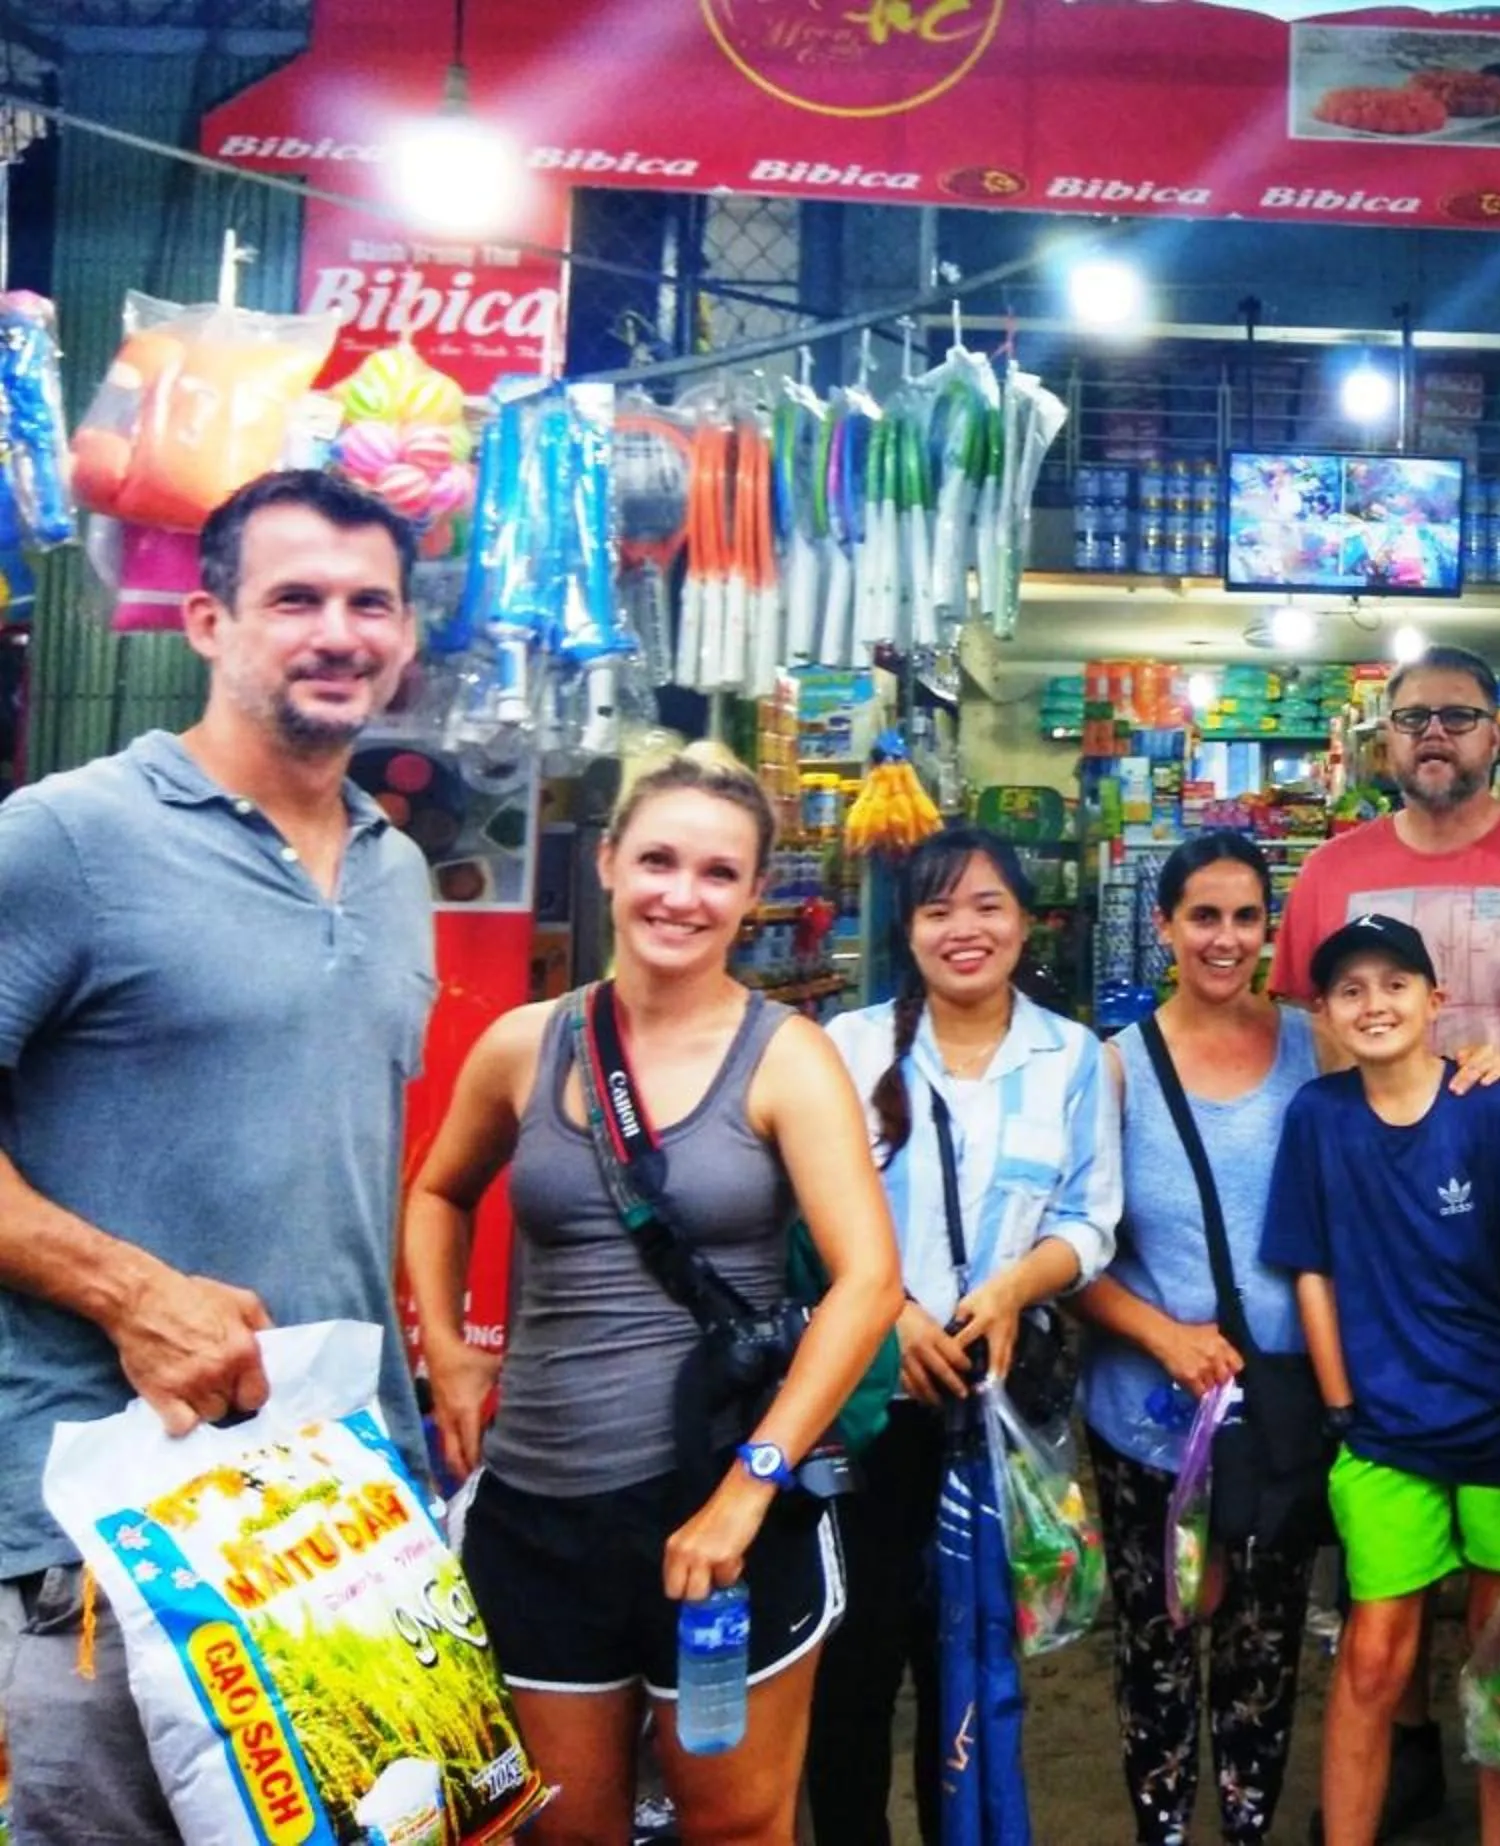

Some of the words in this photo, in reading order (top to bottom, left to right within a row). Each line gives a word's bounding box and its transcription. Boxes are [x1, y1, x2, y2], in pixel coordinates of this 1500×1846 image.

[527, 146, 699, 177] Bibica
[749, 159, 921, 189] Bibica
[1046, 175, 1212, 206] Bibica
[1260, 186, 1422, 214] Bibica
[304, 267, 562, 337] Bibica
[608, 1070, 641, 1138] Canon
[1439, 1202, 1475, 1217] adidas
[205, 1639, 258, 1716] GẠO
[242, 1720, 304, 1827] SẠCH
